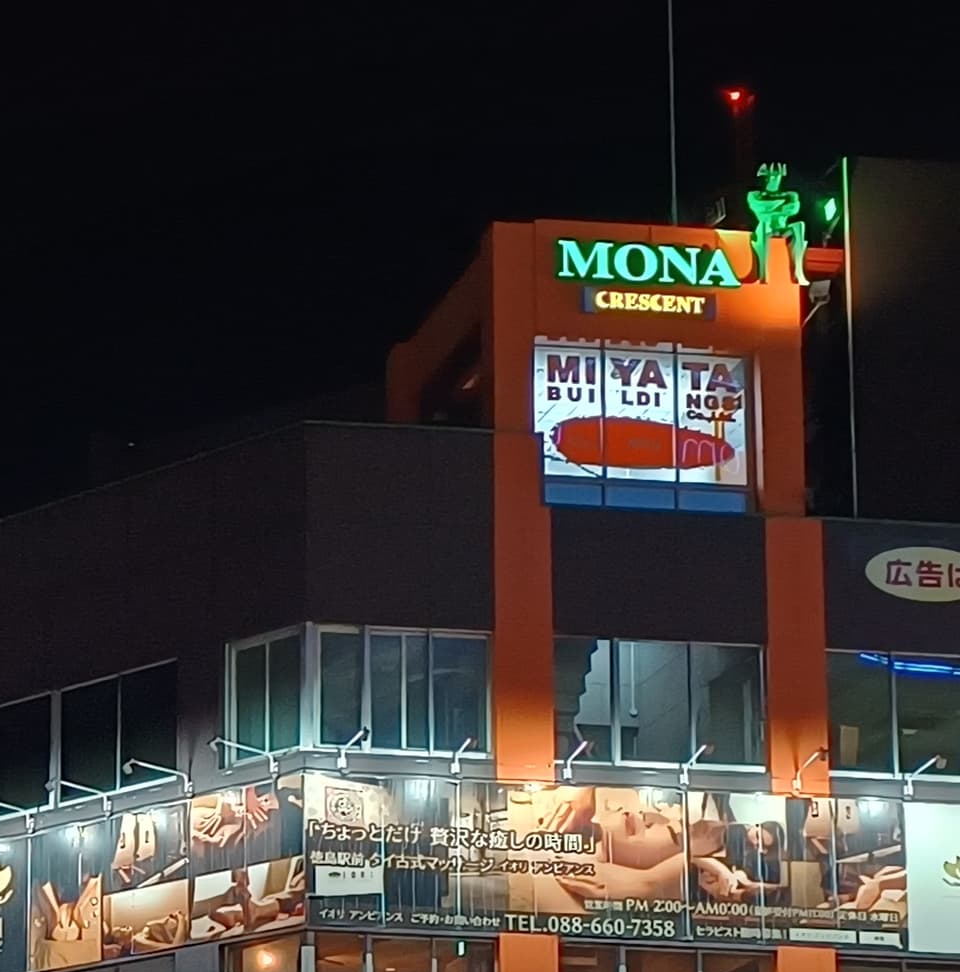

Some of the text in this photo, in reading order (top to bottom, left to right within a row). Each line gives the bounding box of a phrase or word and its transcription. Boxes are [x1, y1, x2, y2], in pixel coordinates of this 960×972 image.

[557, 238, 742, 287] MONA
[595, 290, 705, 315] CRESCENT
[626, 899, 649, 912] PM
